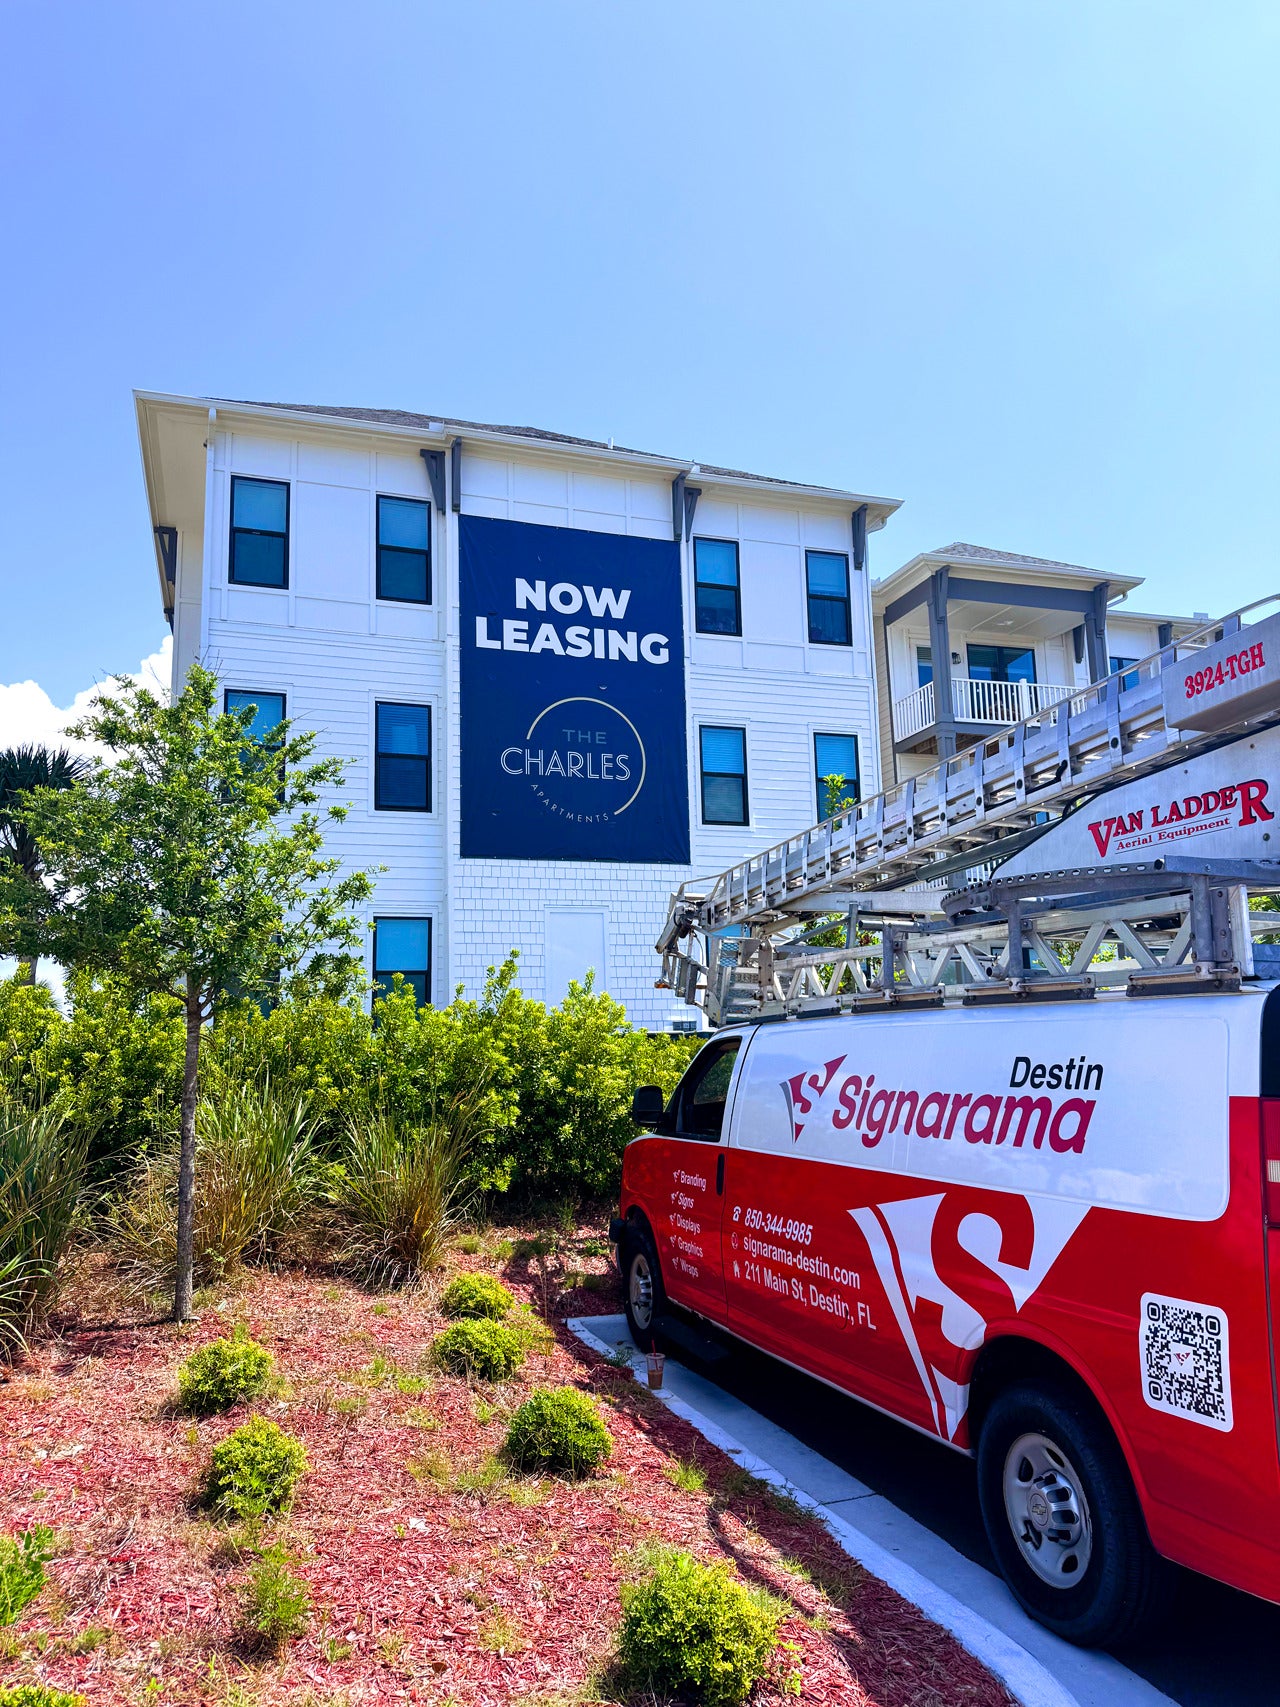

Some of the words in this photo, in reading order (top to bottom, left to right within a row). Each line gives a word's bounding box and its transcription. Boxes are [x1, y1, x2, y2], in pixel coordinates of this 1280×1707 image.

[515, 578, 631, 619] NOW
[475, 616, 670, 665] LEASING
[1184, 642, 1265, 698] 3924-TGH
[562, 729, 607, 745] THE
[500, 747, 631, 781] CHARLES
[531, 783, 610, 823] APARTMENTS
[1088, 810, 1144, 858] VAN
[1151, 779, 1274, 828] LADDER
[1116, 831, 1153, 851] Aerial
[1158, 816, 1230, 840] Equipment
[1010, 1056, 1104, 1091] Destin
[832, 1074, 1097, 1154] Signarama
[680, 1170, 707, 1191] Branding
[677, 1193, 694, 1209] Signs
[676, 1213, 701, 1234] Displays
[744, 1207, 813, 1246] 850-344-9985
[677, 1236, 704, 1258] Graphics
[743, 1234, 861, 1290] signarama-destin.com
[680, 1258, 699, 1278] Wraps
[745, 1260, 761, 1285] 211
[763, 1269, 789, 1296] Main
[791, 1278, 808, 1306] St,
[809, 1285, 855, 1326] Destin,
[857, 1301, 877, 1331] FL
